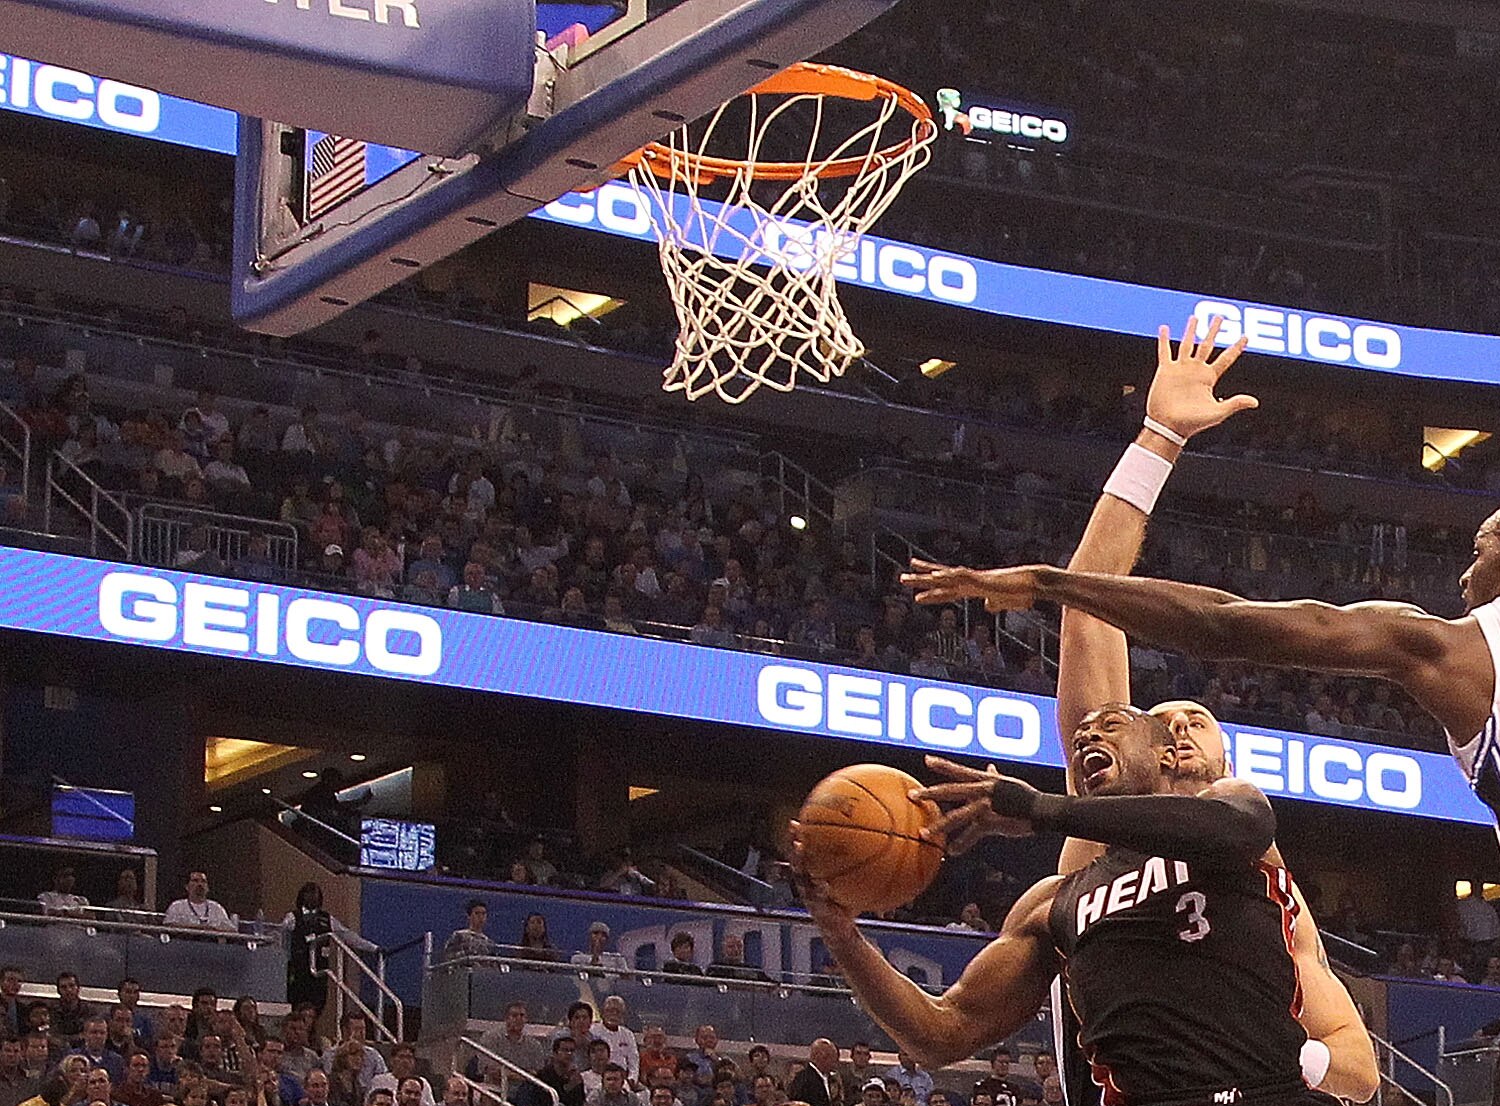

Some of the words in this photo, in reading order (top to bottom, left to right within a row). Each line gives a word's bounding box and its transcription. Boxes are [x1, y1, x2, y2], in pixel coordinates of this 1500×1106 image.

[0, 54, 160, 133] ICO
[968, 106, 1068, 143] GEICO
[764, 222, 976, 303] GEICO
[1194, 300, 1402, 369] GEICO
[99, 571, 443, 676] GEICO
[756, 665, 1042, 757] GEICO
[1222, 730, 1423, 809] EICO
[1175, 891, 1212, 943] 3
